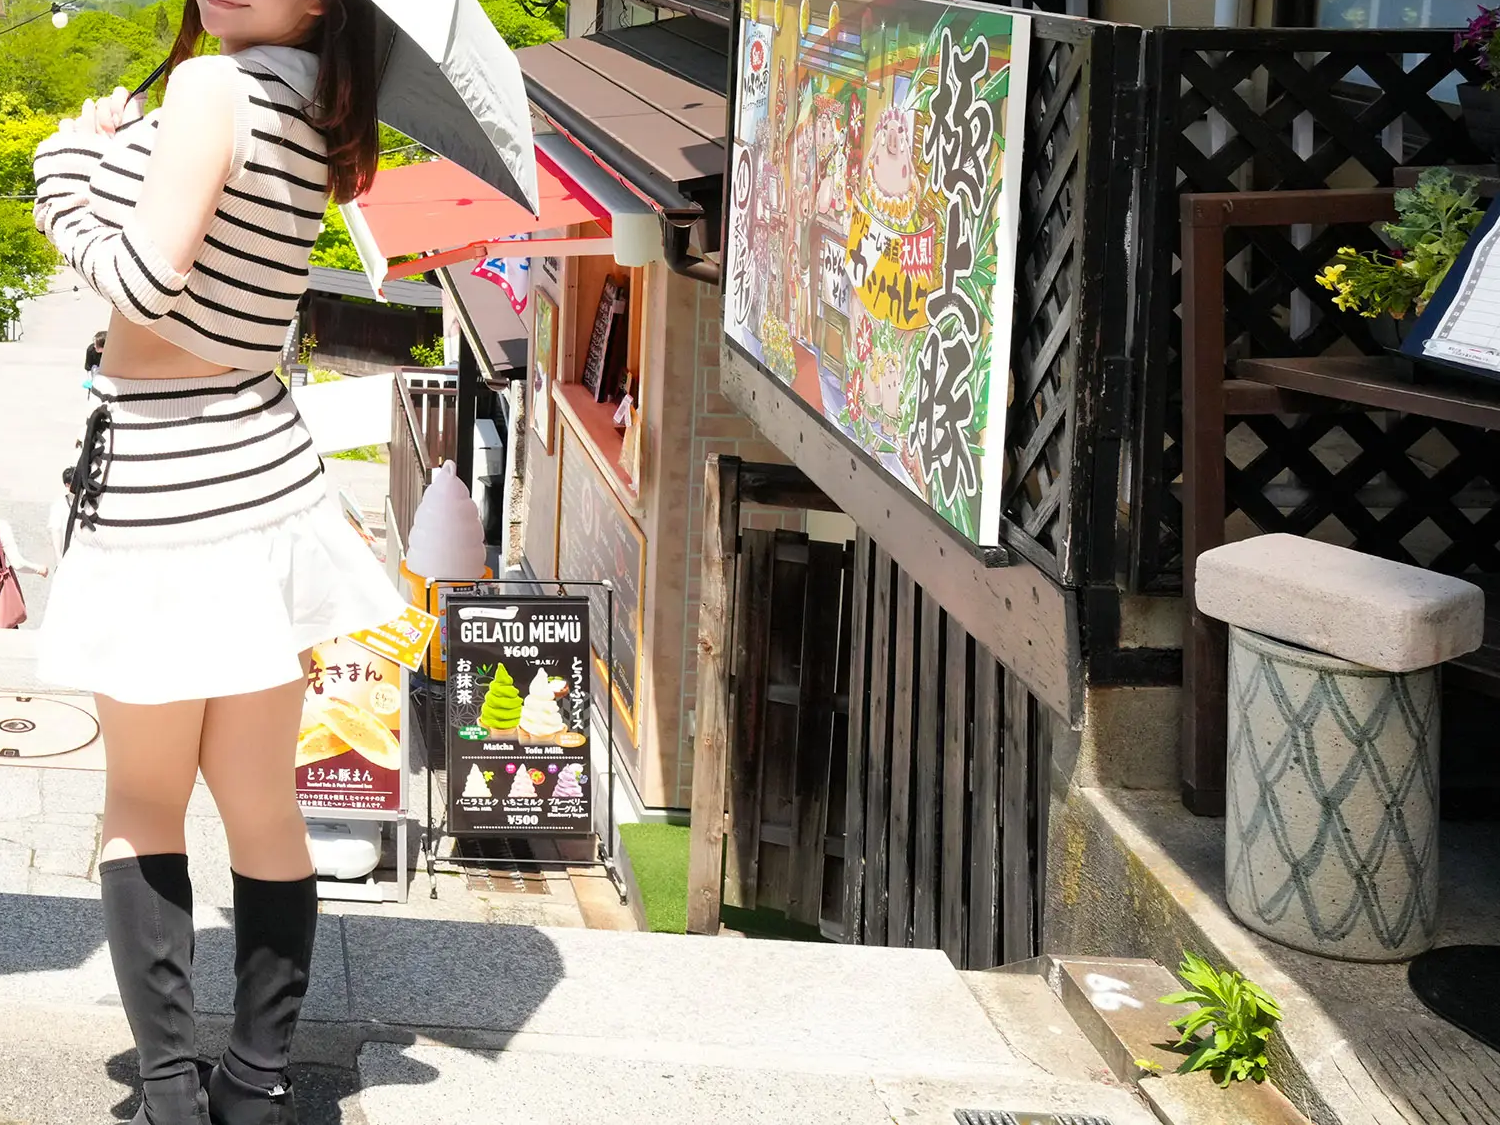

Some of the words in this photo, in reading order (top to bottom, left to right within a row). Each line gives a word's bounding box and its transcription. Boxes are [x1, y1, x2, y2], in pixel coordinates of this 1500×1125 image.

[910, 28, 993, 506] 極上豚
[460, 621, 524, 644] GELATO
[529, 621, 582, 644] MEMU
[503, 645, 539, 658] ¥600
[456, 658, 473, 705] お抹茶
[569, 656, 586, 730] とうふアイス
[483, 742, 515, 751] Matcha
[524, 746, 543, 755] Tofu
[544, 746, 565, 755] Milk
[306, 767, 374, 782] とうふ豚まん
[502, 798, 544, 806] いちごミルク
[507, 814, 539, 826] ¥500
